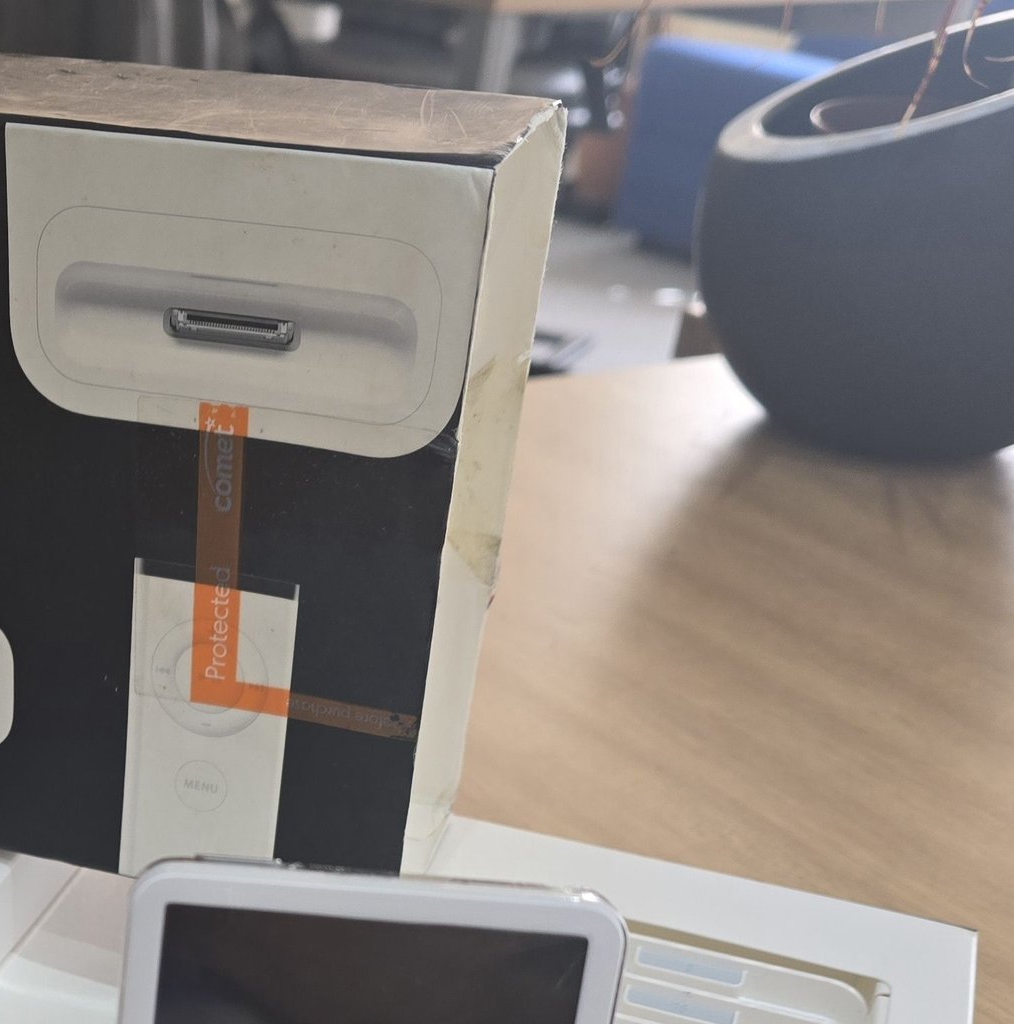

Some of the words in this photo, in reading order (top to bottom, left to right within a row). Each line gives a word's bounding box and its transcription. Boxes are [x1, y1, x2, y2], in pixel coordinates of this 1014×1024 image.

[214, 422, 234, 513] comet
[206, 566, 231, 681] Protected
[184, 779, 219, 794] MENU
